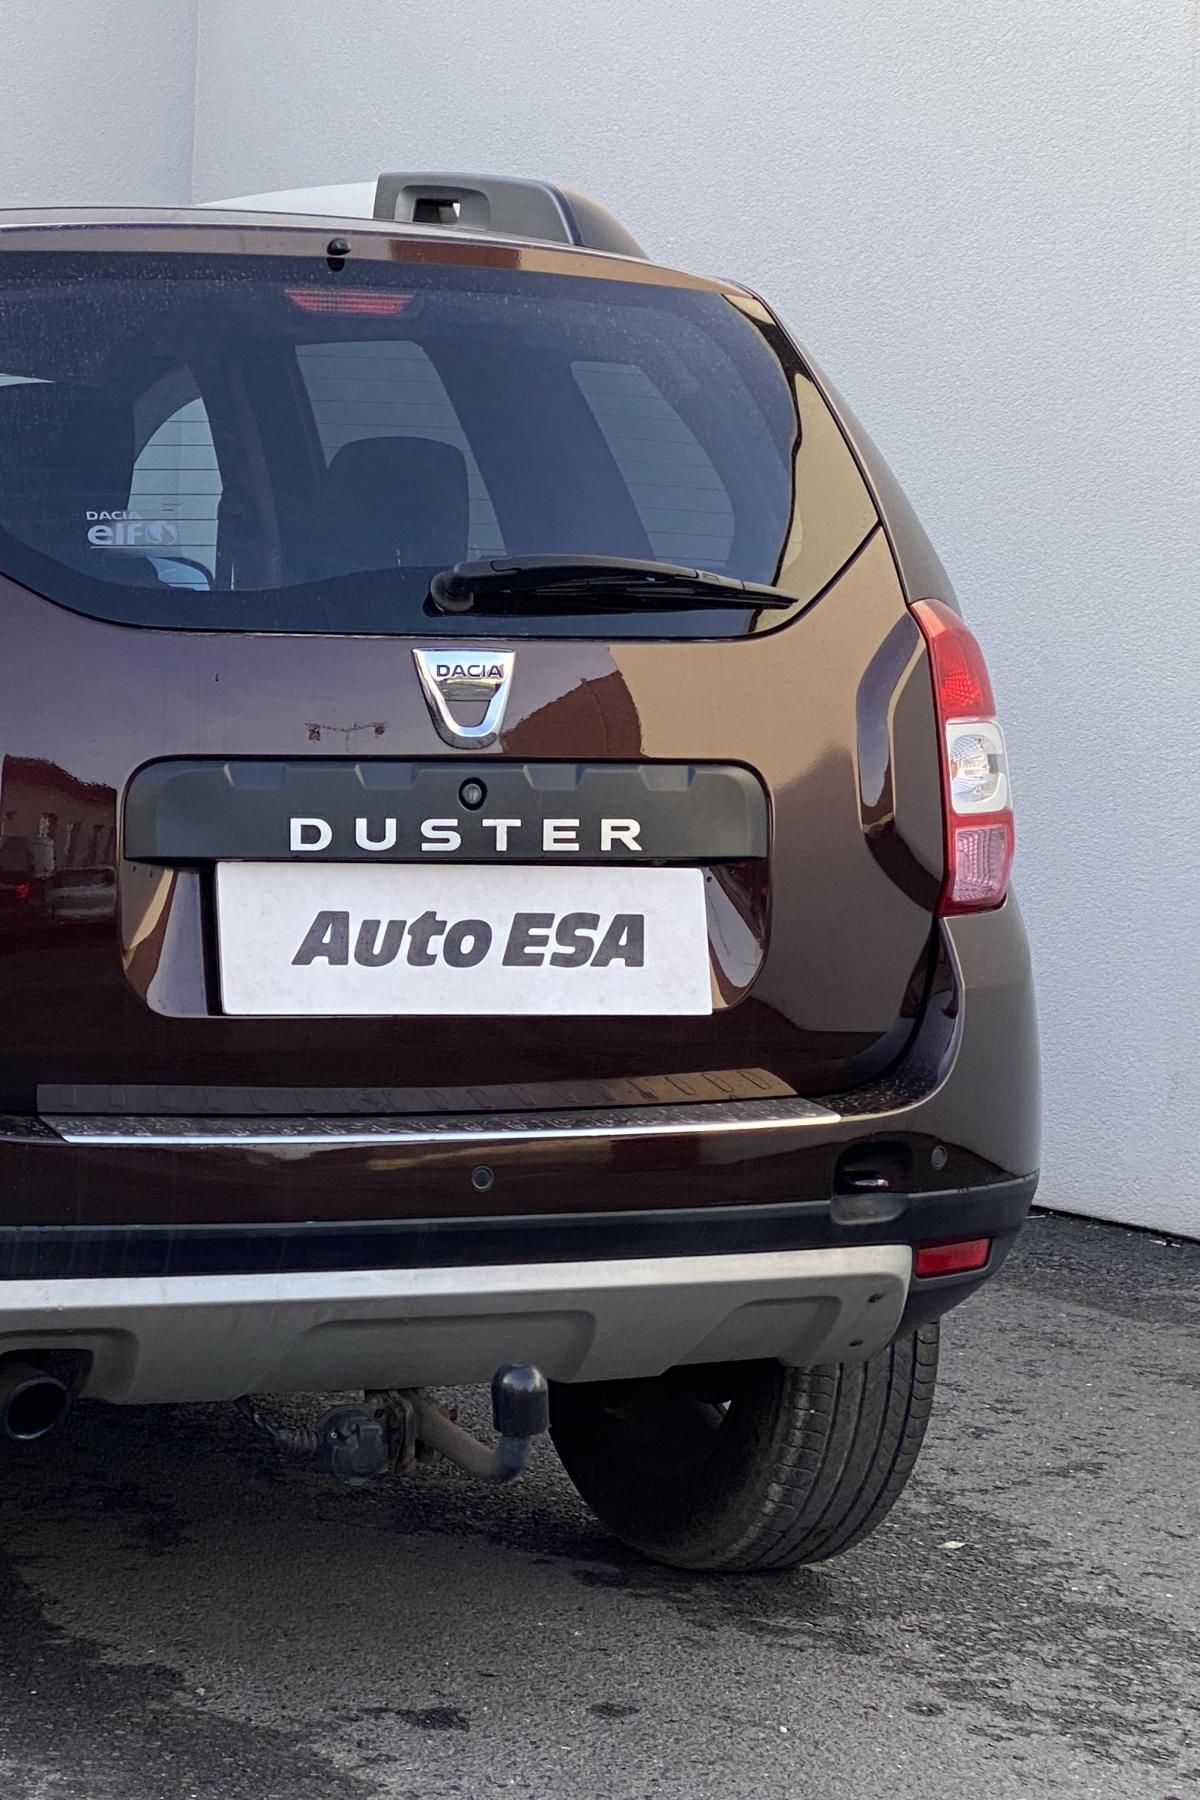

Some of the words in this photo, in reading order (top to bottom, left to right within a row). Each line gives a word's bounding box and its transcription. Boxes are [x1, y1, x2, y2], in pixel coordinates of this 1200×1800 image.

[86, 511, 141, 520] DACIA
[87, 523, 143, 545] elf
[436, 664, 502, 677] DACIA
[289, 817, 643, 851] DUSTER
[291, 909, 492, 968] Auto
[502, 911, 646, 968] ESA
